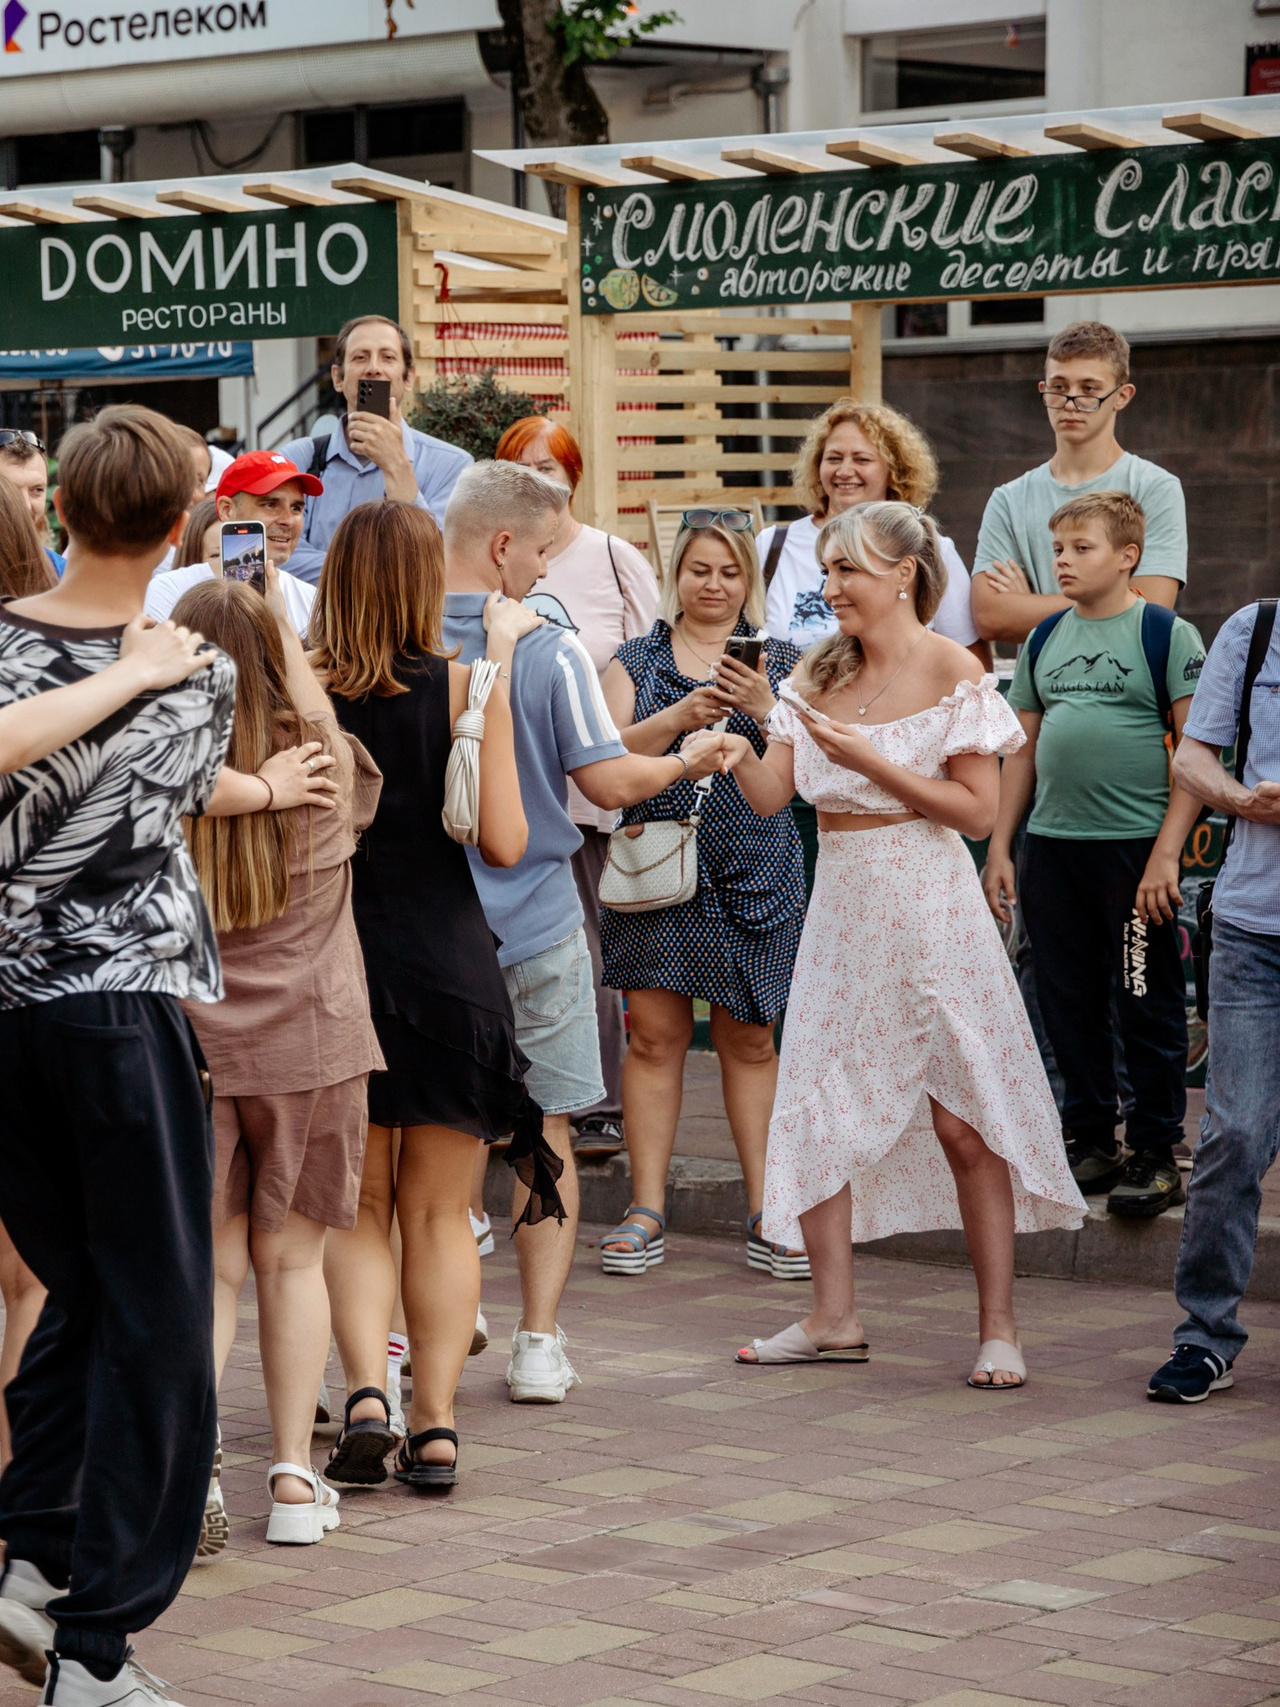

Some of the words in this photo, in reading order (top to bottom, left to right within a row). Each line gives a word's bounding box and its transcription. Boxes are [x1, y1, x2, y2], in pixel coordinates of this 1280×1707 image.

[38, 1, 267, 50] Ростелеком
[610, 172, 1039, 270] Смоленские
[1094, 157, 1280, 238] Слас
[720, 254, 912, 300] авторские
[939, 248, 1129, 292] десерты
[1142, 247, 1171, 275] и
[1193, 237, 1280, 277] пря
[122, 301, 287, 332] рестораны
[1050, 681, 1126, 694] DAGESTAN
